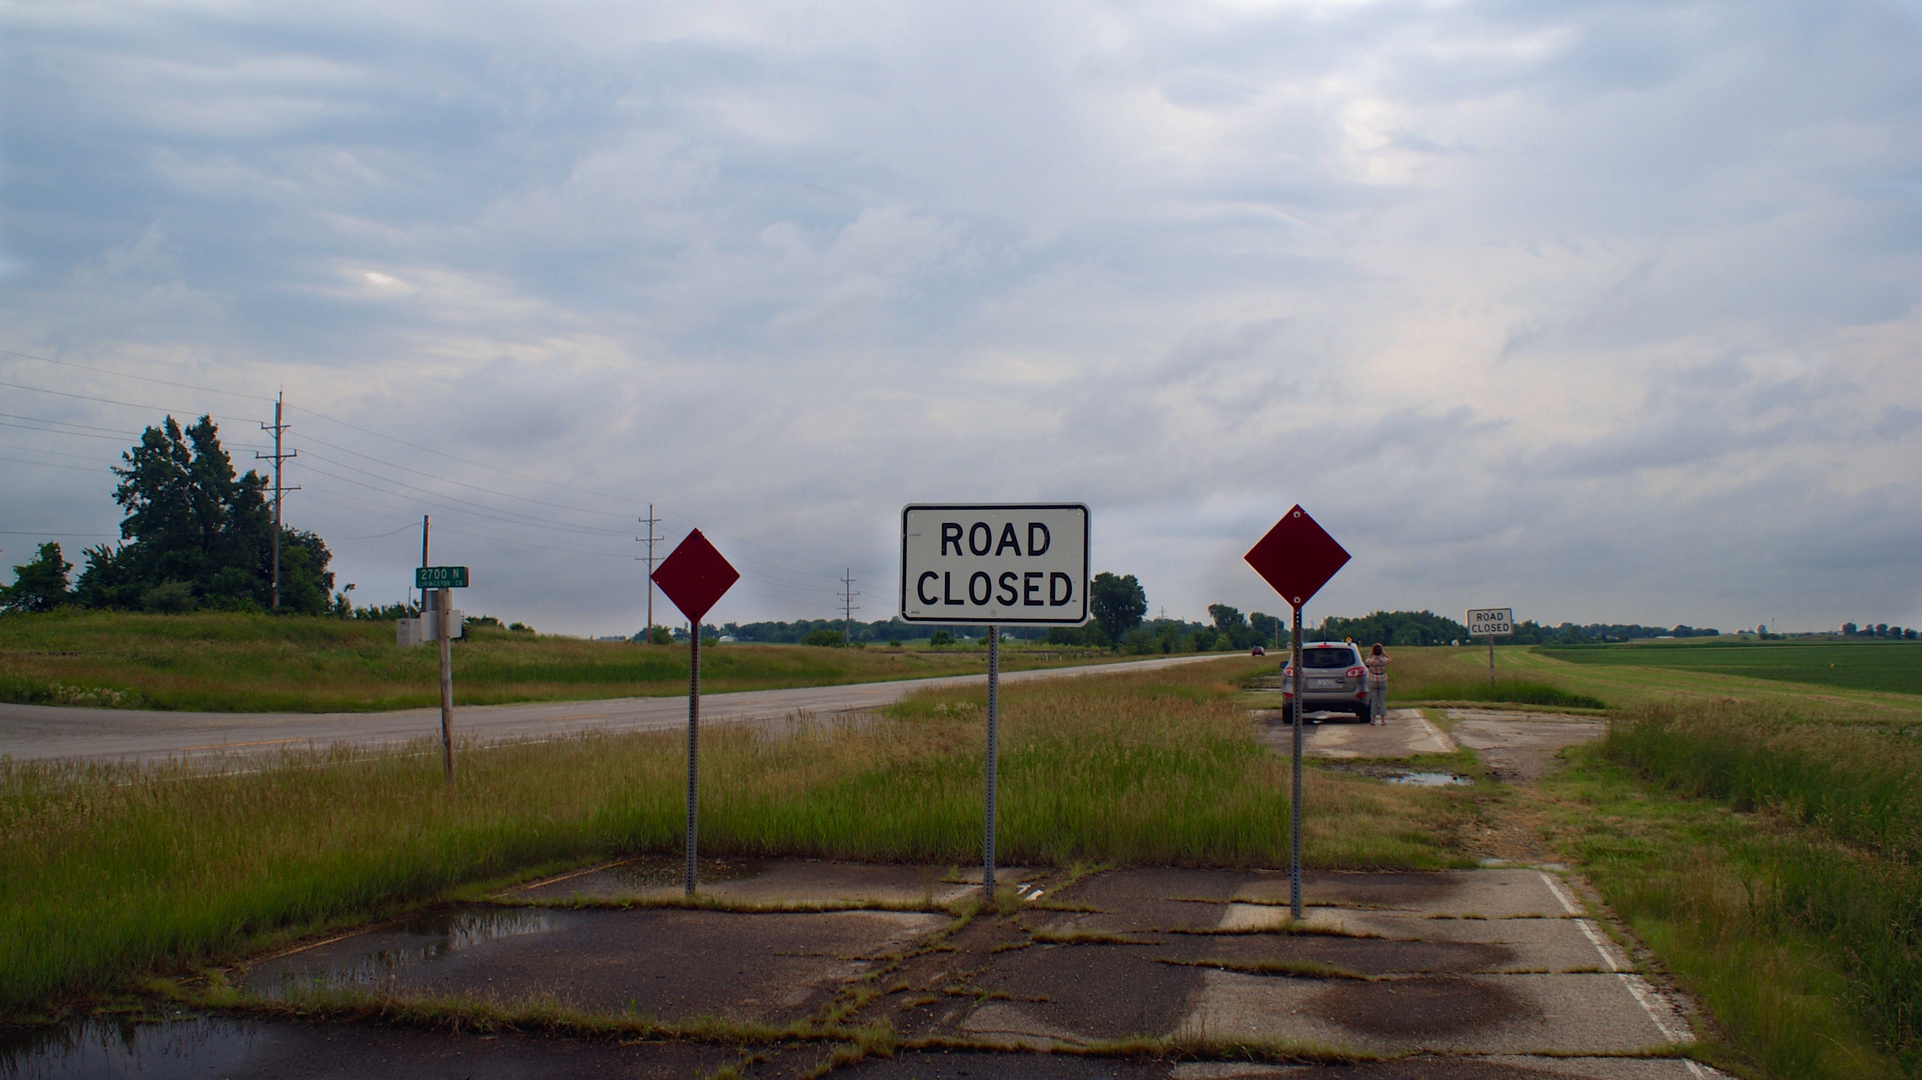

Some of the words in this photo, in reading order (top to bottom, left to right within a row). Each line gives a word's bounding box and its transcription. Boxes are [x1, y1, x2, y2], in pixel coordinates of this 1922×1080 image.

[941, 522, 1050, 556] ROAD
[421, 569, 447, 580] 2700
[453, 568, 459, 579] N
[917, 571, 1072, 606] CLOSED
[1476, 612, 1504, 621] ROAD
[1471, 623, 1509, 632] CLOSED
